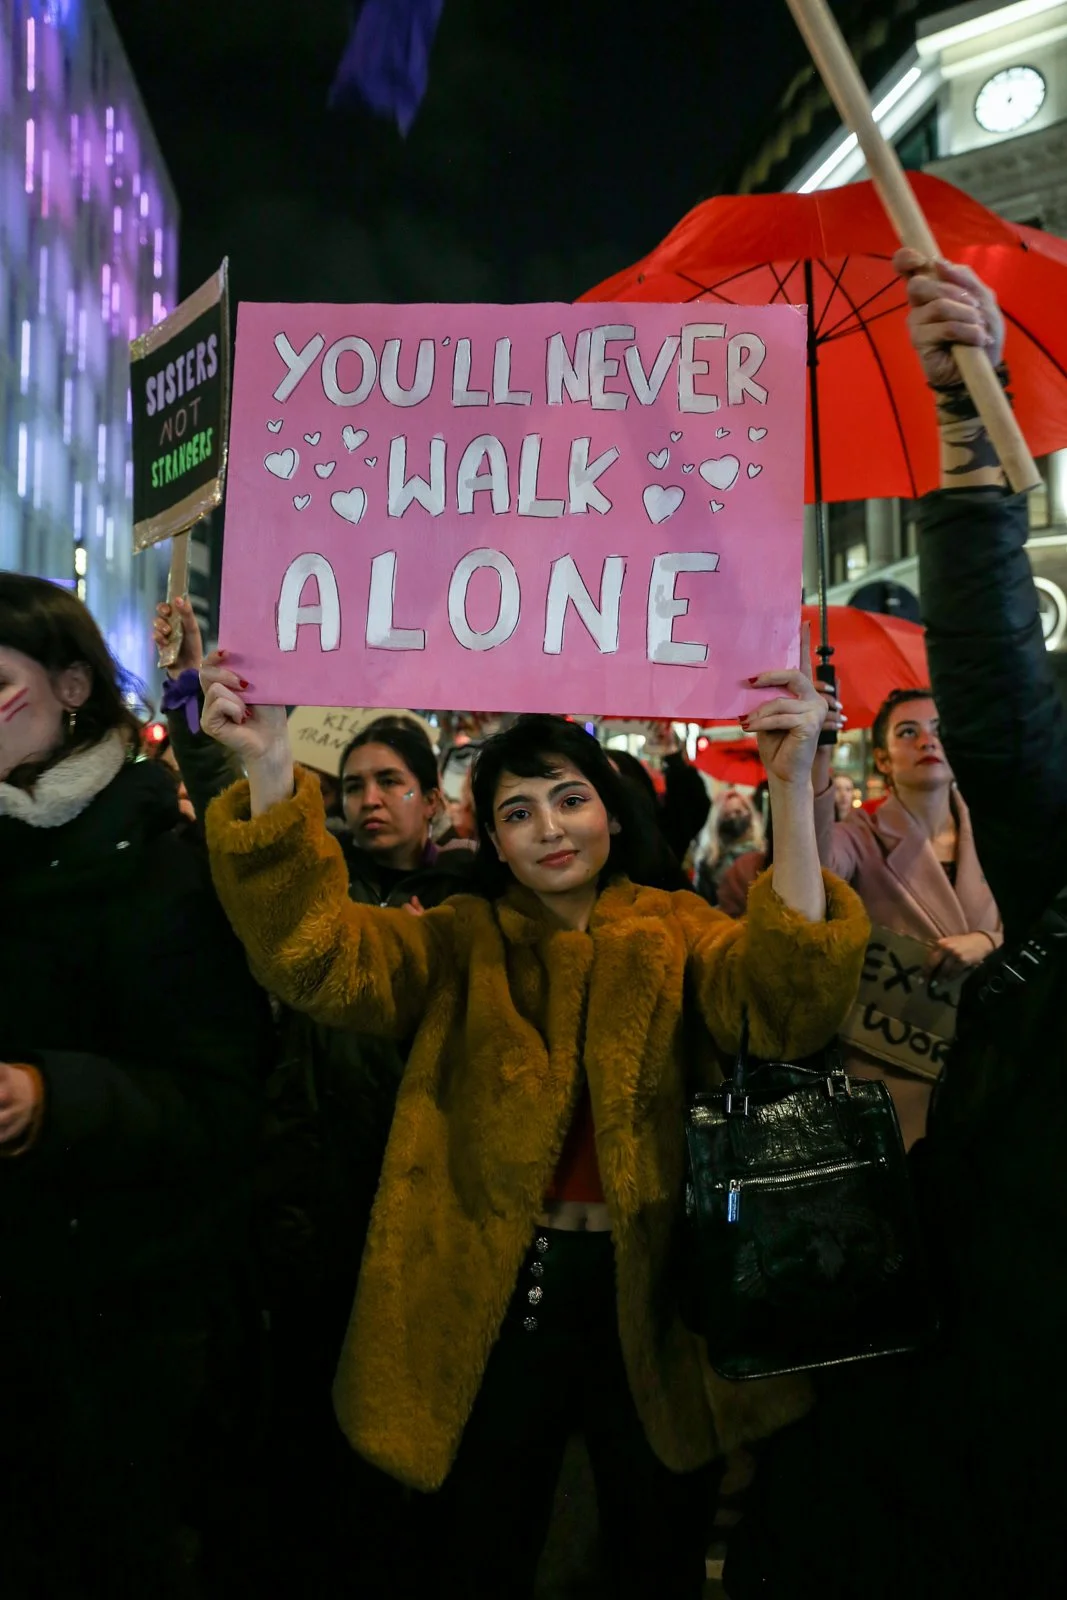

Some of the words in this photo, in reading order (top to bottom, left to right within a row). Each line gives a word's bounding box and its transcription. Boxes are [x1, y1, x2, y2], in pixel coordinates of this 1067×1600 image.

[146, 334, 218, 416] SISTERS
[273, 331, 532, 408] YOU'LL
[546, 323, 769, 413] NEVER
[152, 427, 213, 488] STRANGERS
[160, 397, 201, 445] NOT
[387, 432, 620, 518] WALK
[275, 547, 721, 668] ALONE
[323, 712, 362, 736] KIL
